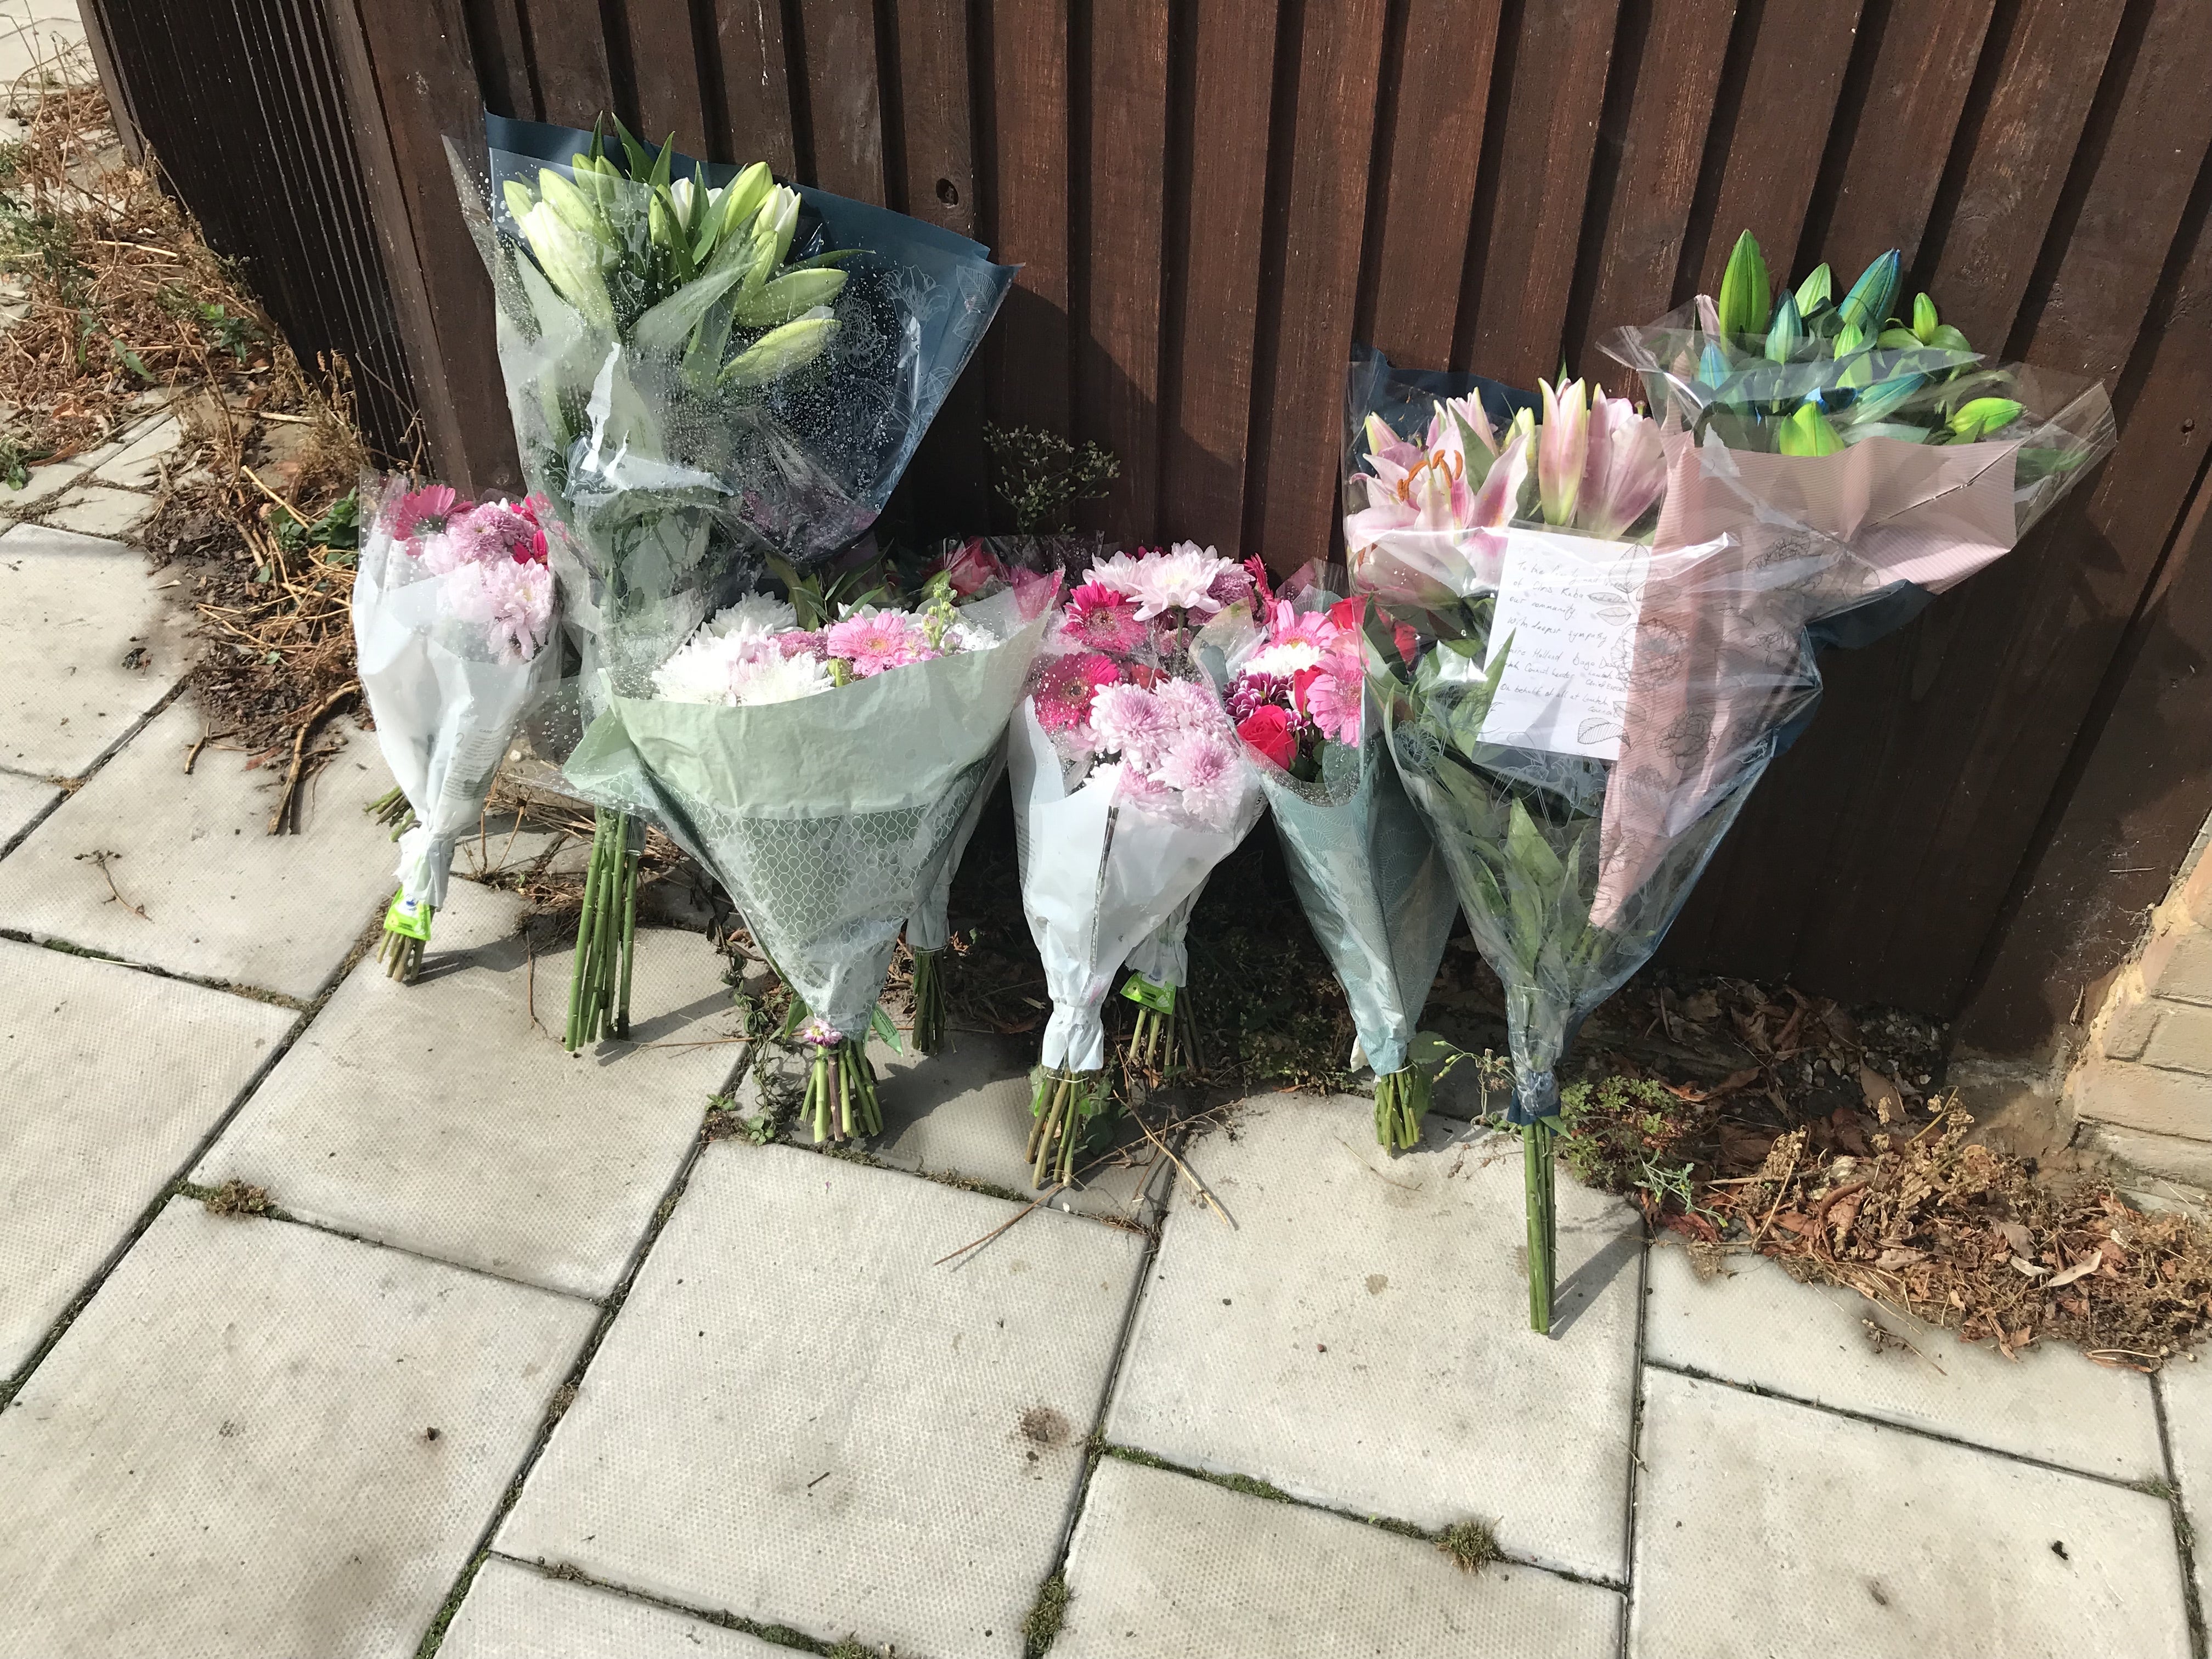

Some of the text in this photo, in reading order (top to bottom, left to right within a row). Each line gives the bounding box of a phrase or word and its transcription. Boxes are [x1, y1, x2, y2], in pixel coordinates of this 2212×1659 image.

[1517, 561, 1527, 571] To
[1551, 563, 1579, 585] fmly
[1513, 577, 1523, 588] of
[1532, 581, 1553, 593] Chris
[1561, 588, 1583, 599] Kaba
[1532, 603, 1575, 620] community
[1531, 621, 1562, 634] deepest
[1568, 630, 1607, 648] sympathy
[1498, 644, 1564, 662] Caire Holland
[1514, 685, 1543, 696] behalf
[1545, 688, 1554, 697] of
[1555, 690, 1566, 698] all
[1585, 679, 1605, 687] Chief
